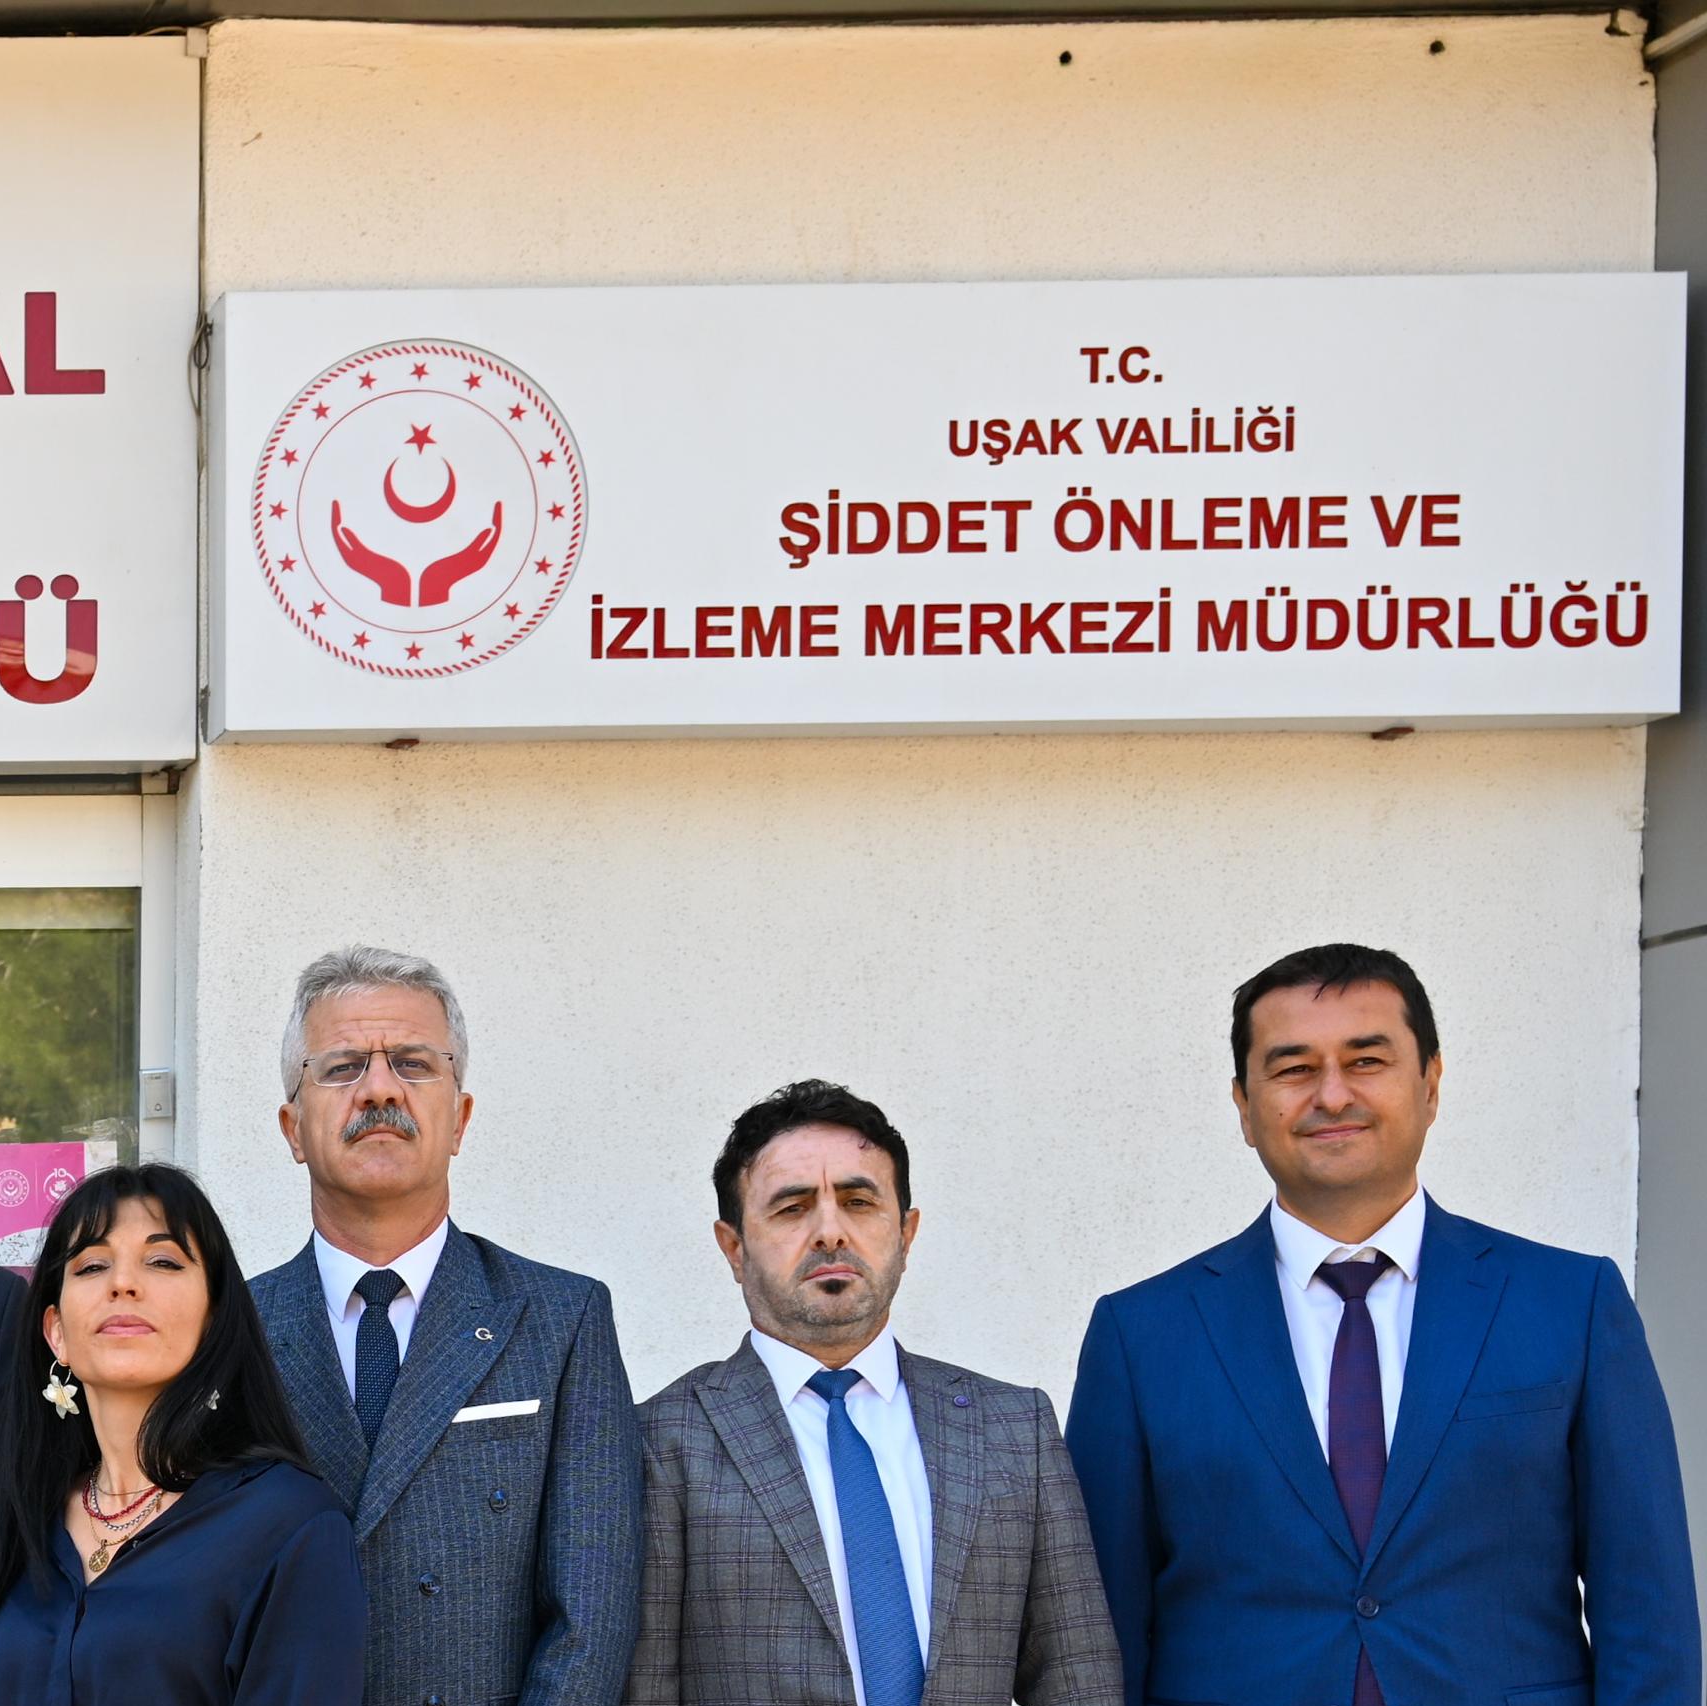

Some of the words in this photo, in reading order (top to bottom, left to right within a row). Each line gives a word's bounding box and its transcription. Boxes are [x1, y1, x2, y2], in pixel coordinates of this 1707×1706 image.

[1080, 346, 1164, 385] T.C.
[948, 418, 1084, 466] UŞAK
[1096, 406, 1296, 455] VALİLİĞİ
[779, 488, 1033, 569] ŞİDDET
[1053, 486, 1349, 553] ÖNLEME
[1370, 494, 1462, 548] VE
[590, 593, 841, 660] İZLEME
[864, 586, 1173, 657] MERKEZİ
[1196, 581, 1650, 653] MÜDÜRLÜĞÜ
